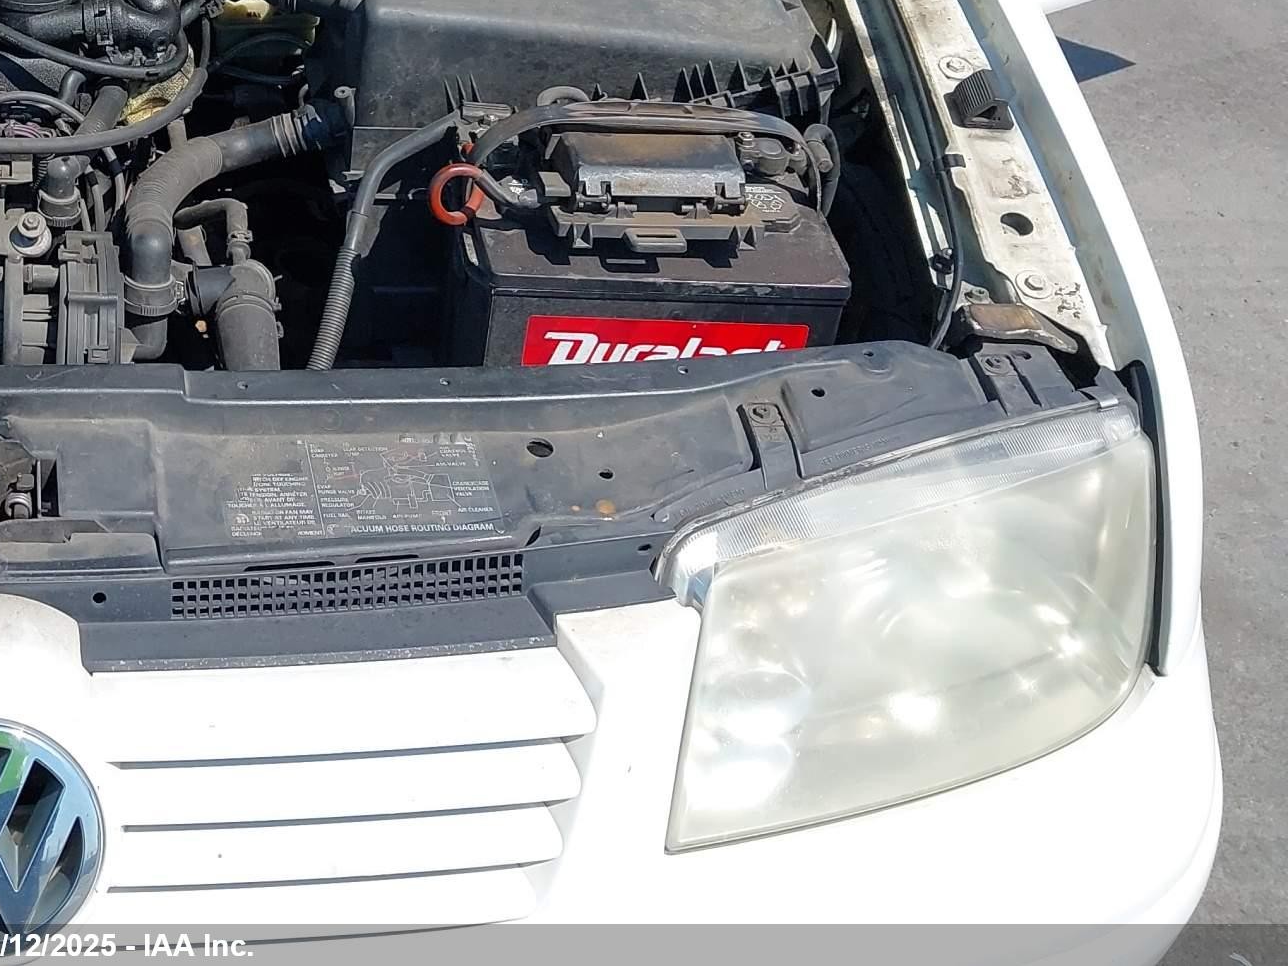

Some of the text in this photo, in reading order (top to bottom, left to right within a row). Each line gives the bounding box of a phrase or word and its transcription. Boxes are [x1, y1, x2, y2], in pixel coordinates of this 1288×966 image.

[544, 332, 787, 365] Dural
[385, 523, 410, 533] HOSE
[411, 523, 451, 533] ROUTING
[452, 522, 495, 532] DIAGRAM
